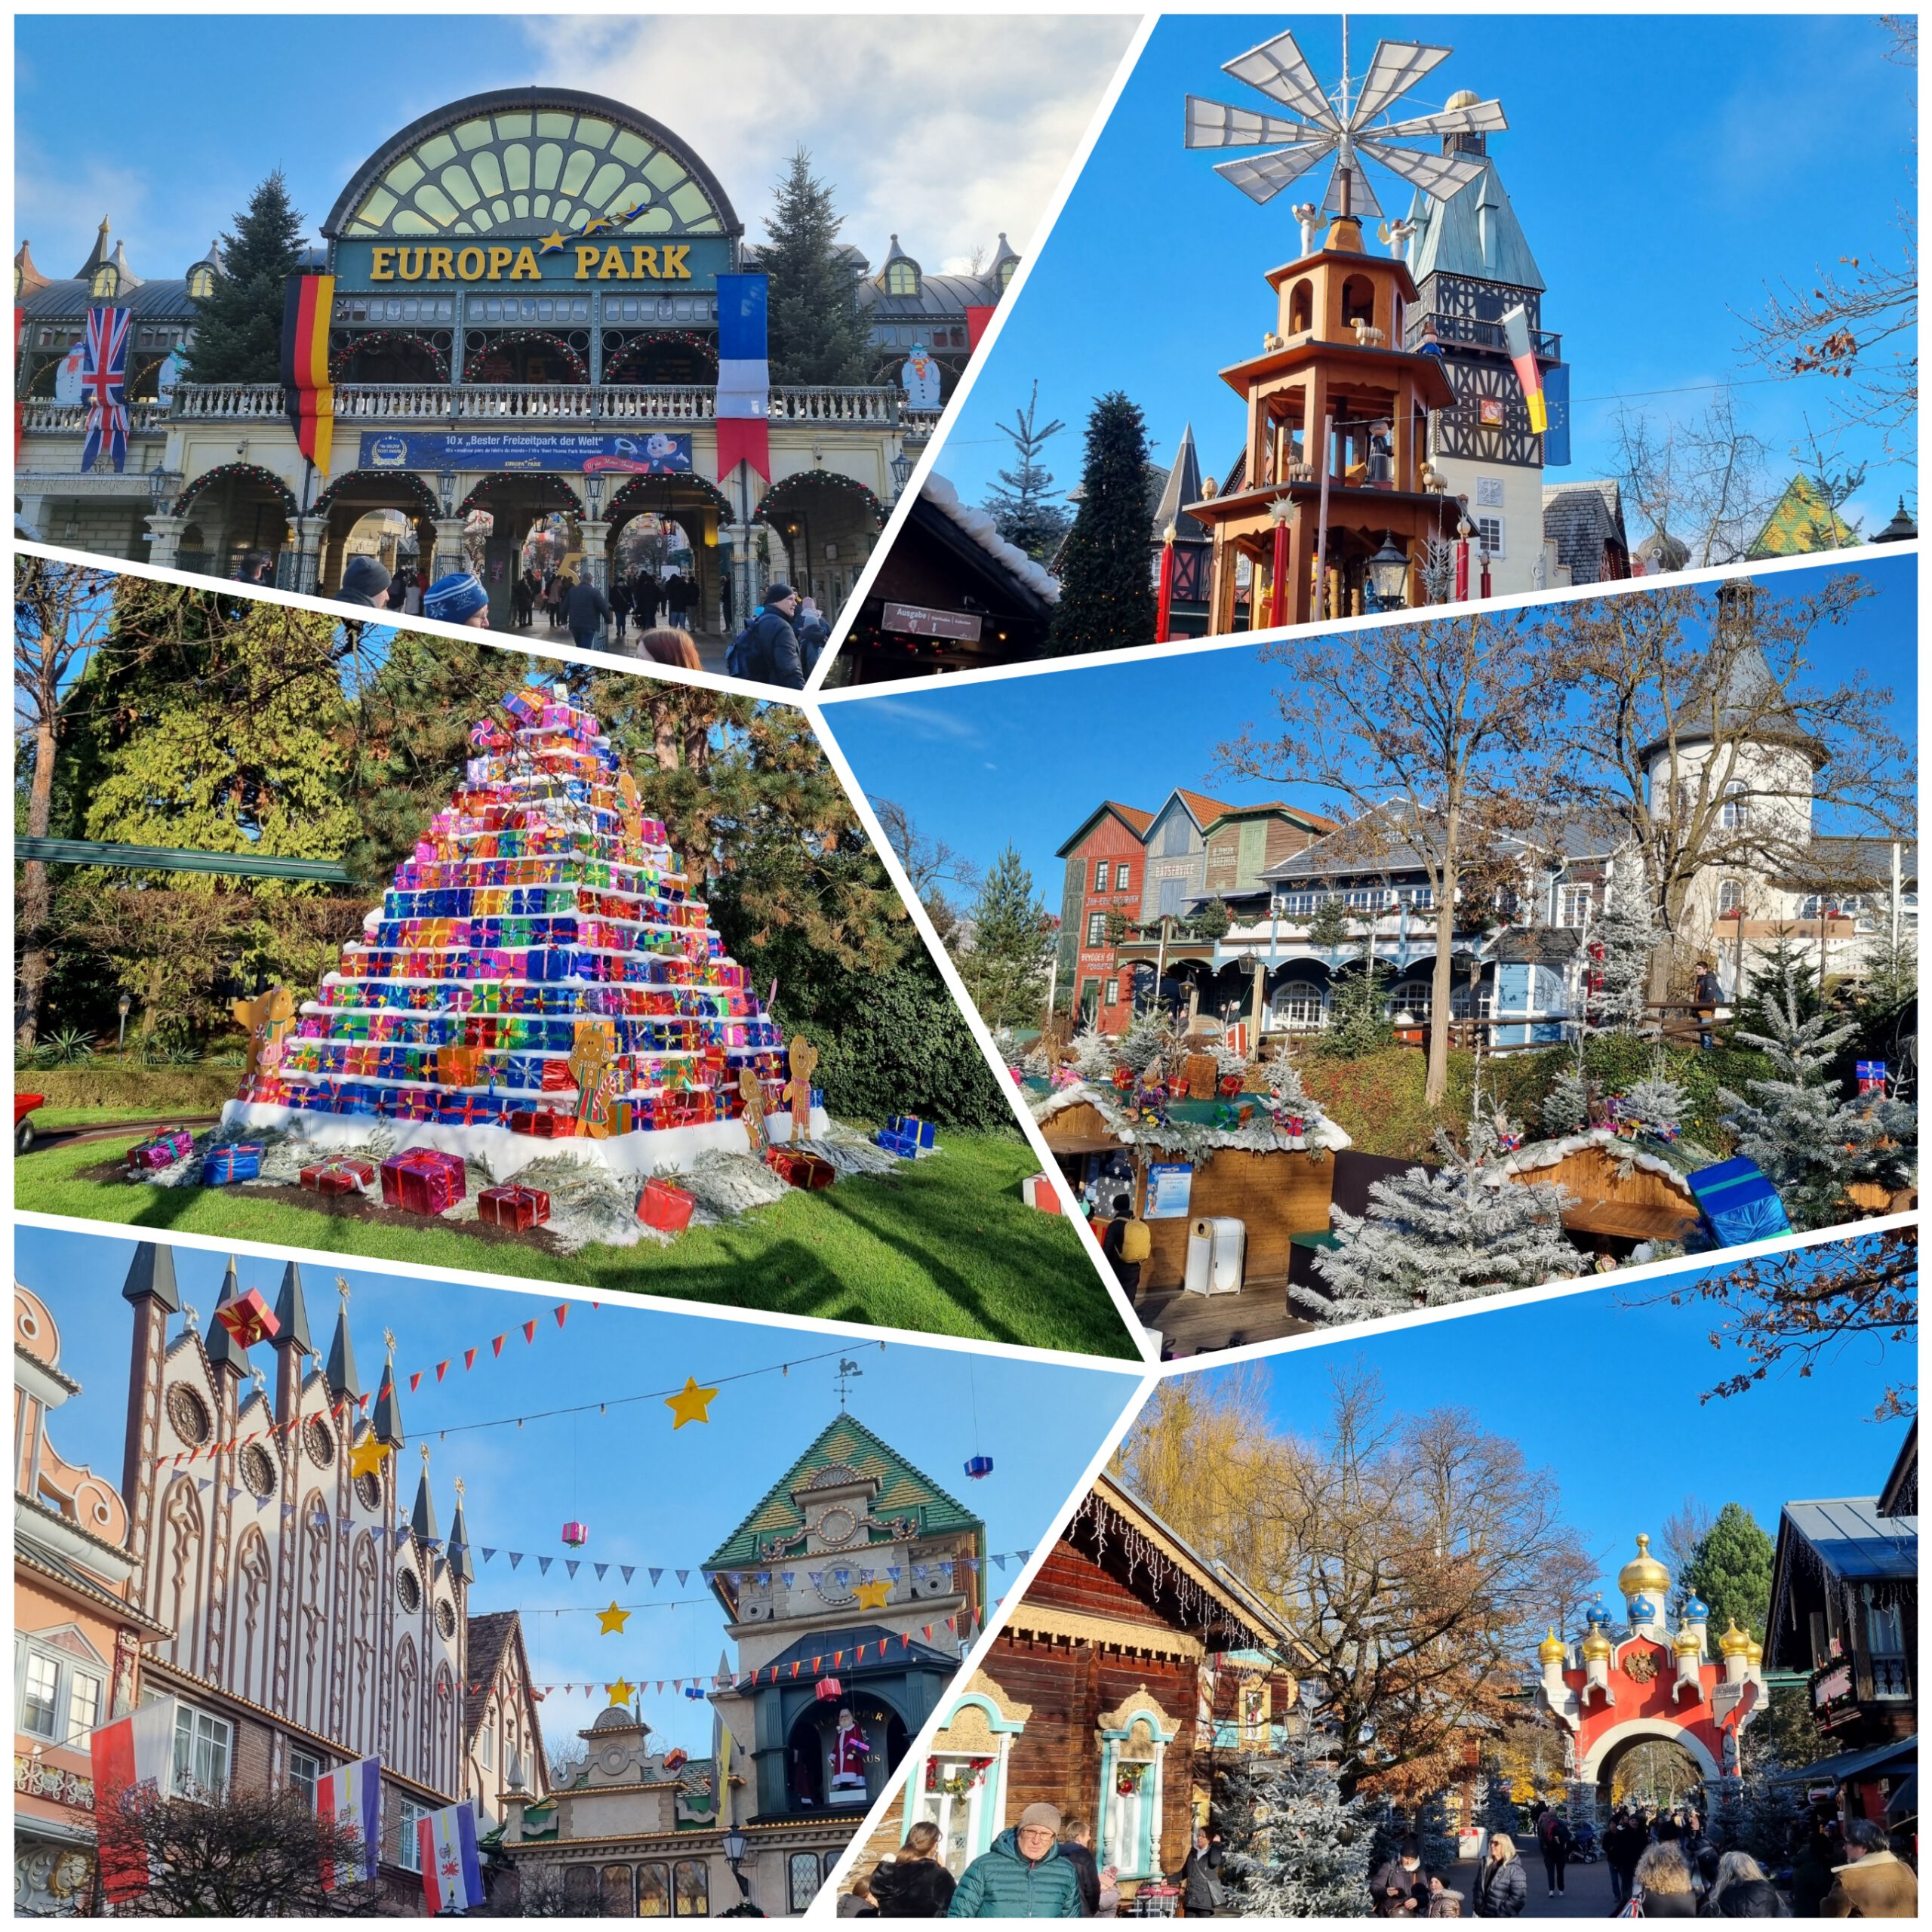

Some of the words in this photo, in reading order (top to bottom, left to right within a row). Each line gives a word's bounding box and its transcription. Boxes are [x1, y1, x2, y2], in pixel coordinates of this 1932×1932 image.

[370, 246, 542, 281] EUROPA
[574, 245, 692, 279] PARK
[503, 435, 558, 447] Freizeitpark
[559, 436, 576, 446] der
[897, 608, 927, 620] Ausgabe
